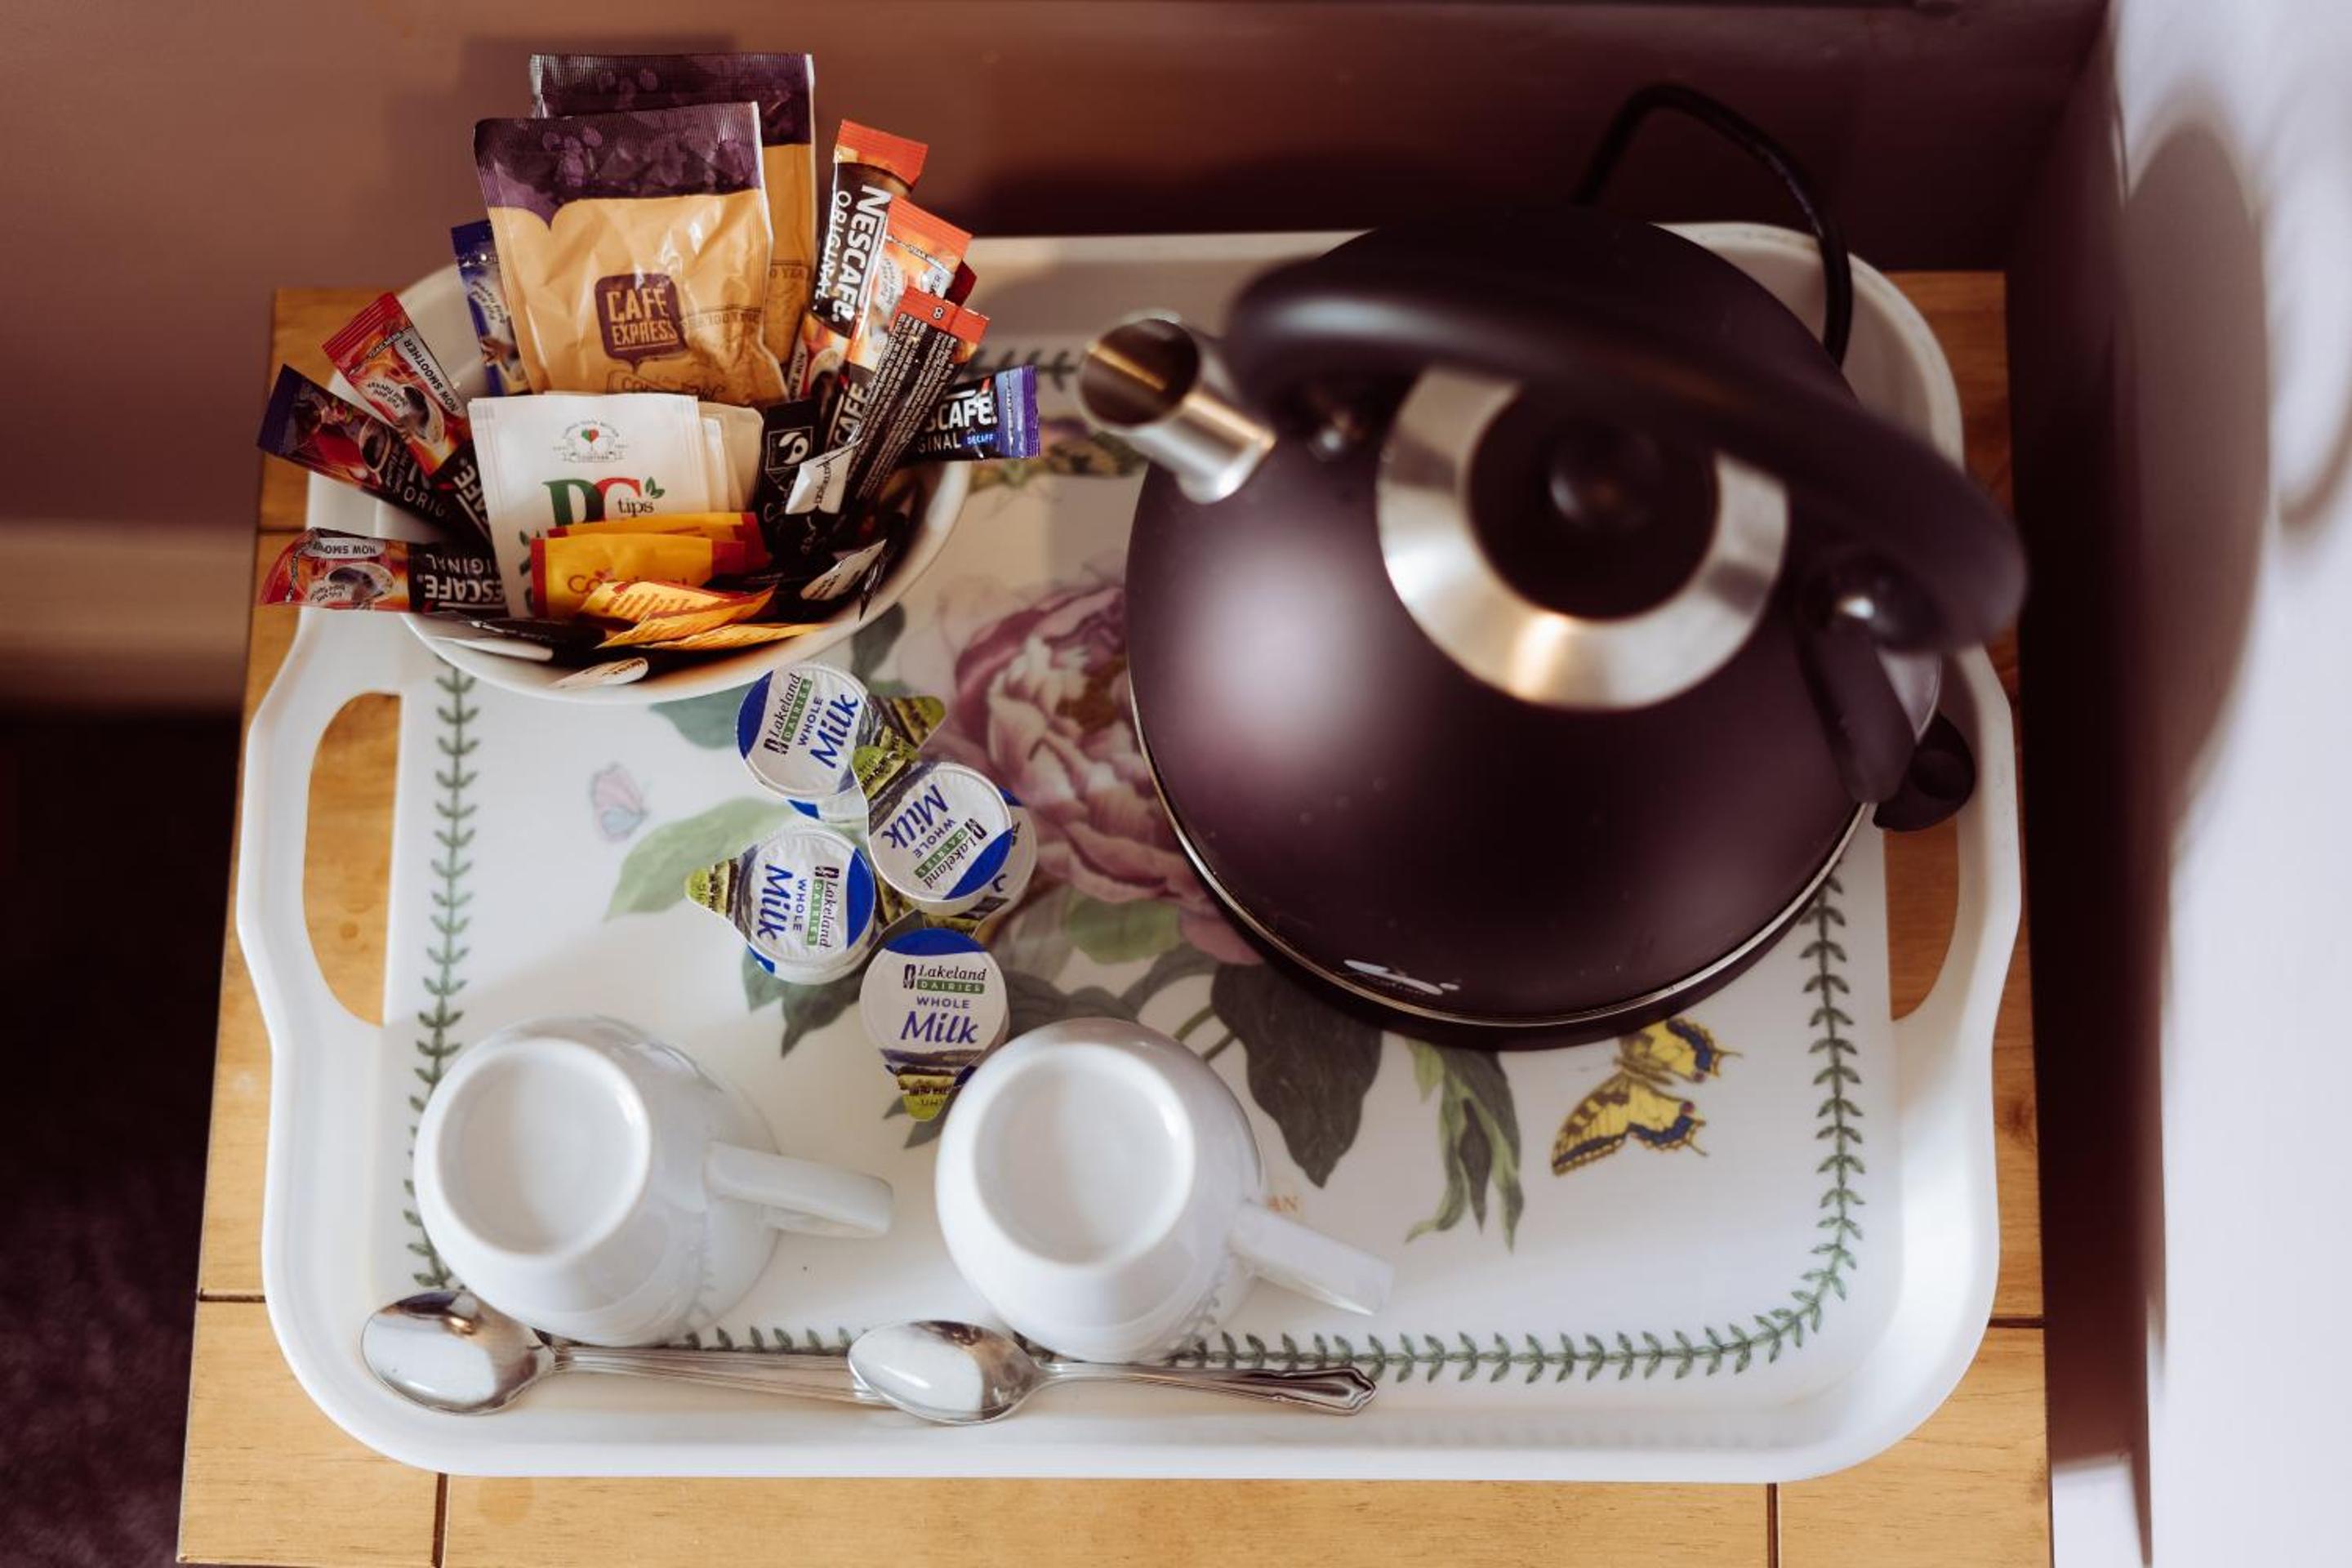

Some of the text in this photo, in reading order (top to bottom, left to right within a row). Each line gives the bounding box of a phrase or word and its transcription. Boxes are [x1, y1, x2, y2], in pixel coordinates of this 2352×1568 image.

[612, 319, 679, 345] EXPRESS
[403, 339, 458, 412] NOW SMOOTHER
[403, 488, 447, 517] ORIG
[617, 498, 654, 518] tips
[425, 554, 490, 575] IGINAL
[771, 673, 802, 737] Lakeland
[797, 697, 823, 746] WHOLE
[809, 693, 859, 768] Milk
[880, 783, 950, 849] Milk
[913, 817, 956, 858] WHOLE
[924, 838, 978, 889] Lakeland
[756, 863, 794, 940] Milk
[792, 879, 808, 932] WHOLE
[819, 880, 839, 948] Lakeland
[918, 965, 987, 981] Lakeland
[920, 980, 982, 993] DAIRIES
[916, 996, 970, 1009] WHOLE
[900, 1011, 979, 1044] Milk
